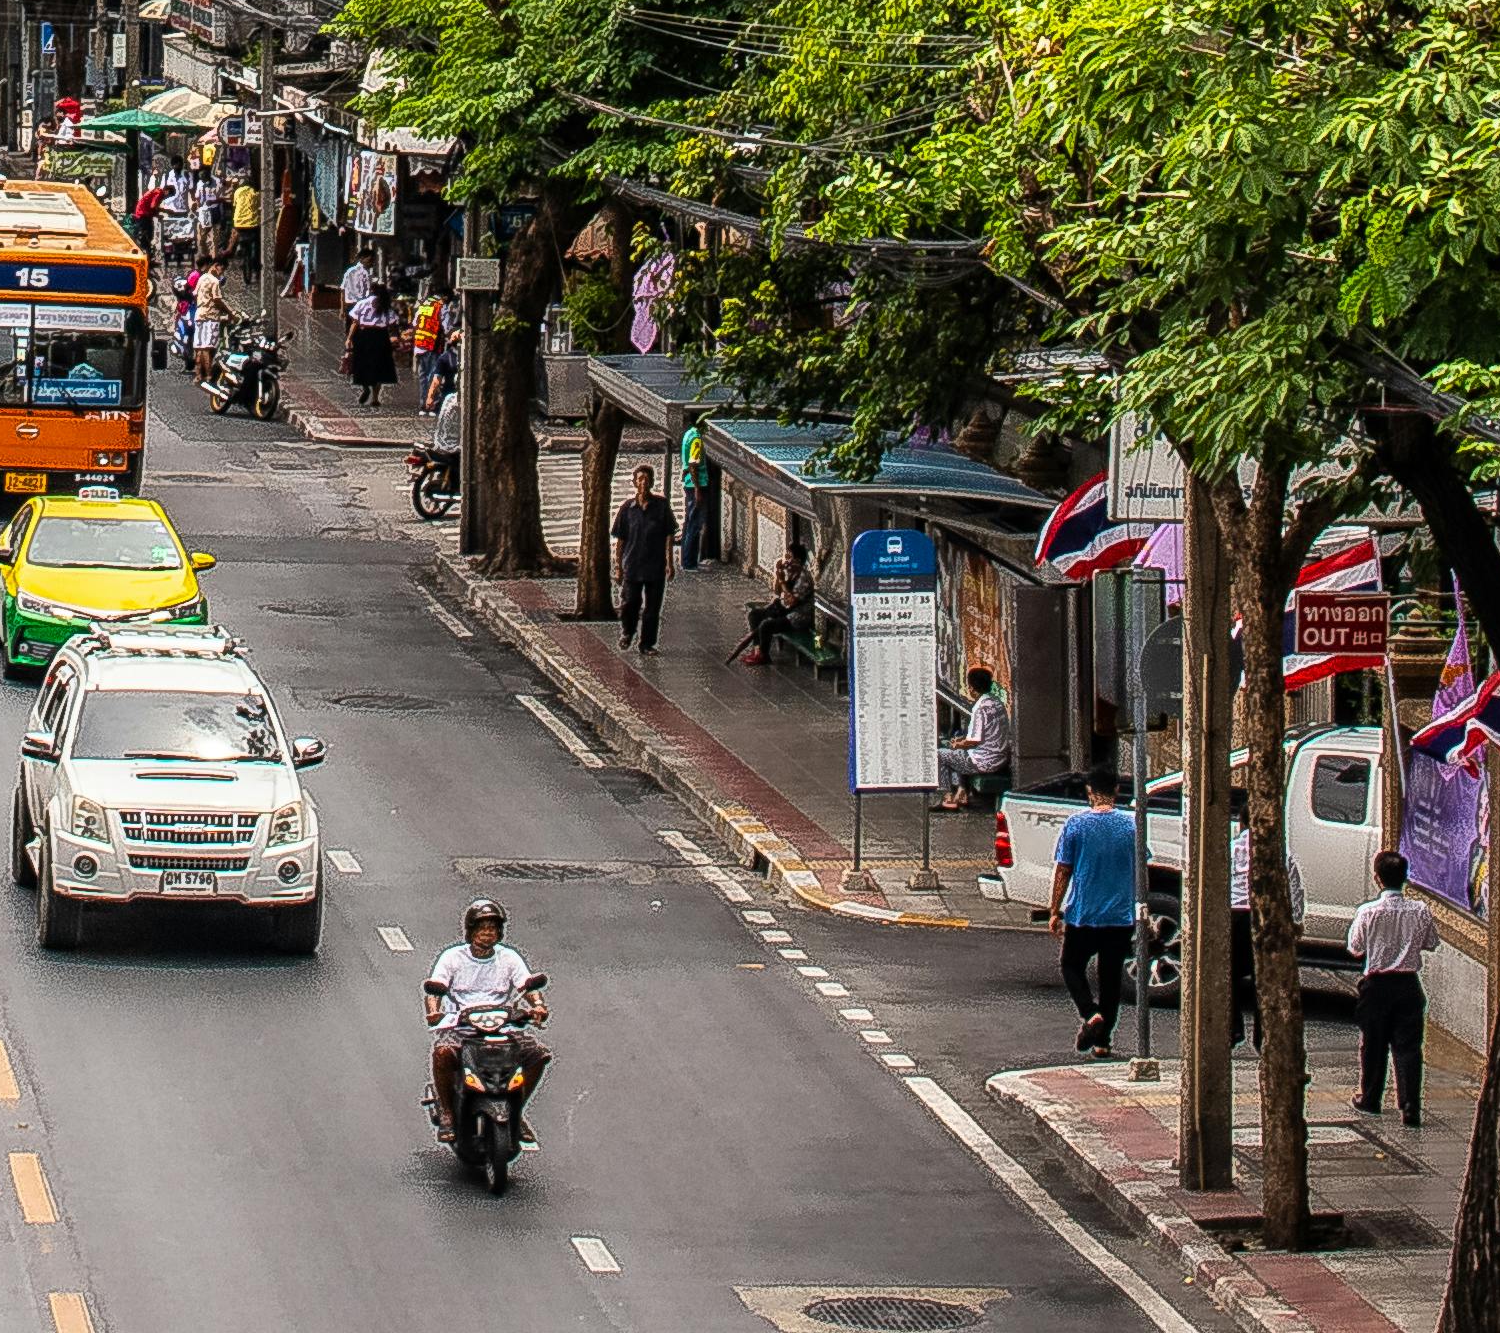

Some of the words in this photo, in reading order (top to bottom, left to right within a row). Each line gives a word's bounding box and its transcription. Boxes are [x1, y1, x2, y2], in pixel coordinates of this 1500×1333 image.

[15, 266, 50, 289] 15
[1303, 606, 1384, 622] ทางออก
[1303, 627, 1350, 646] OUT
[1352, 630, 1383, 646] 出口
